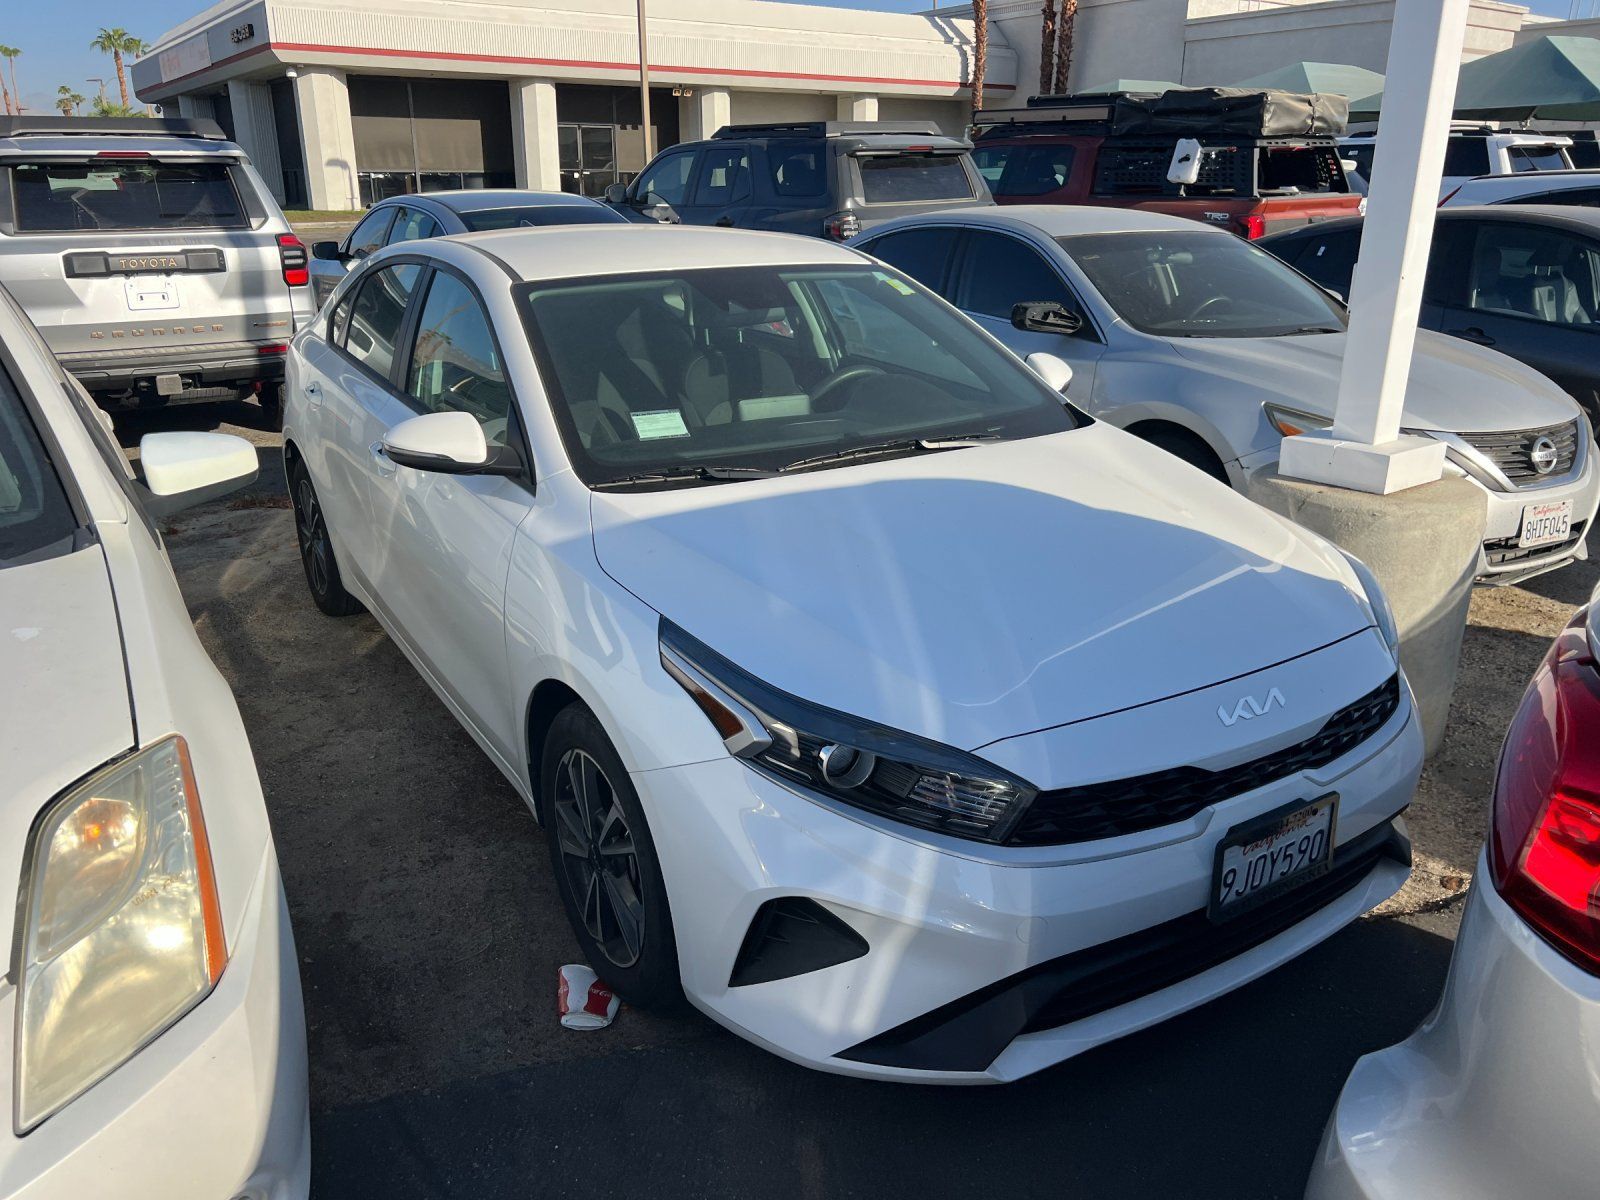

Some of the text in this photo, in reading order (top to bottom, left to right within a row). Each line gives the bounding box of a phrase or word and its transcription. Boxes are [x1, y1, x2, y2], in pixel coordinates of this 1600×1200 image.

[1204, 211, 1229, 220] TRD
[119, 258, 178, 269] TOYOTA
[1526, 514, 1568, 540] 8HIF045
[1217, 687, 1286, 727] KIA
